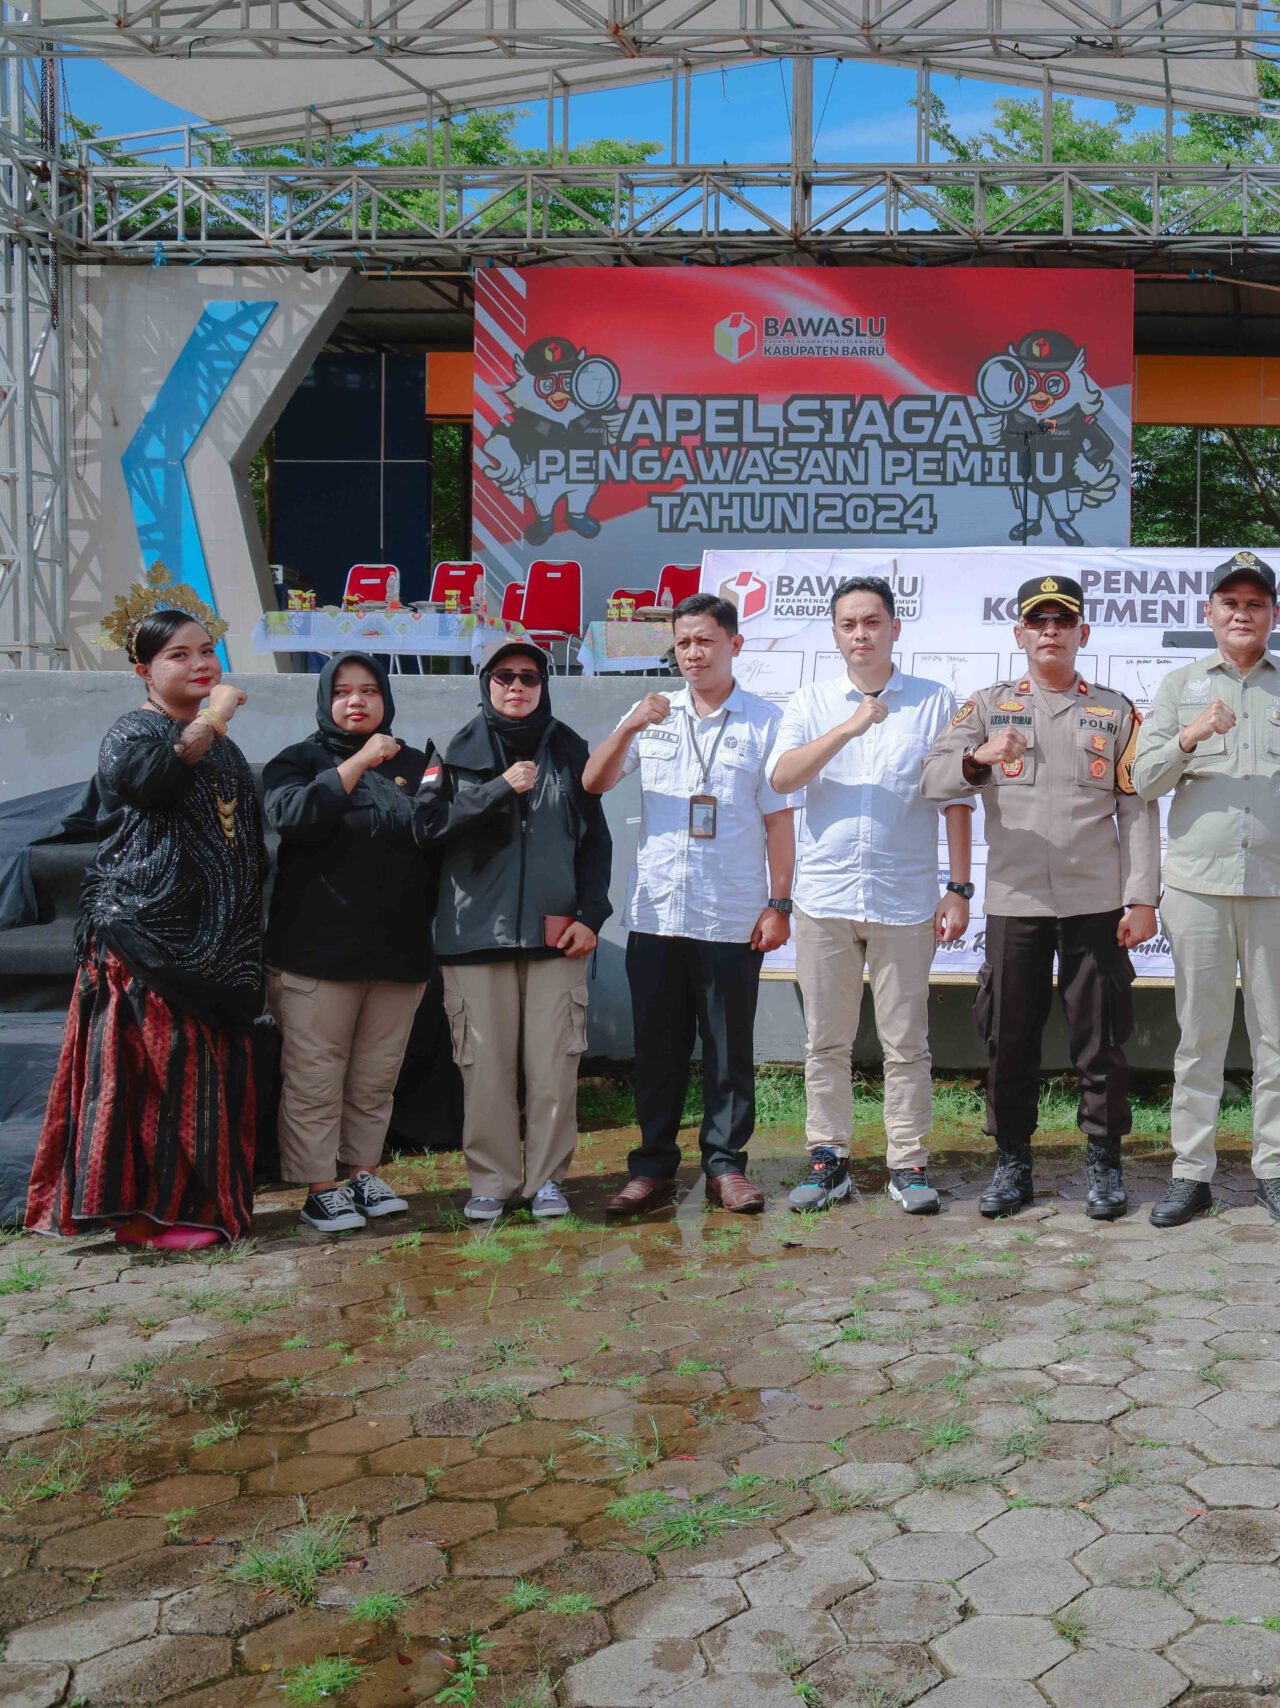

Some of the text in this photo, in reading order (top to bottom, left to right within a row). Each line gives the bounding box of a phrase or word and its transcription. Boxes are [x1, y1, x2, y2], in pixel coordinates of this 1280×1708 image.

[763, 316, 886, 338] BAWASLU
[763, 345, 885, 357] KABUPATEN BARRU
[619, 400, 983, 445] APEL SIAGA
[537, 449, 1065, 485] PENGAWASAN PEMILU
[650, 494, 936, 533] TAHUN 2024
[1079, 718, 1118, 735] POLRI
